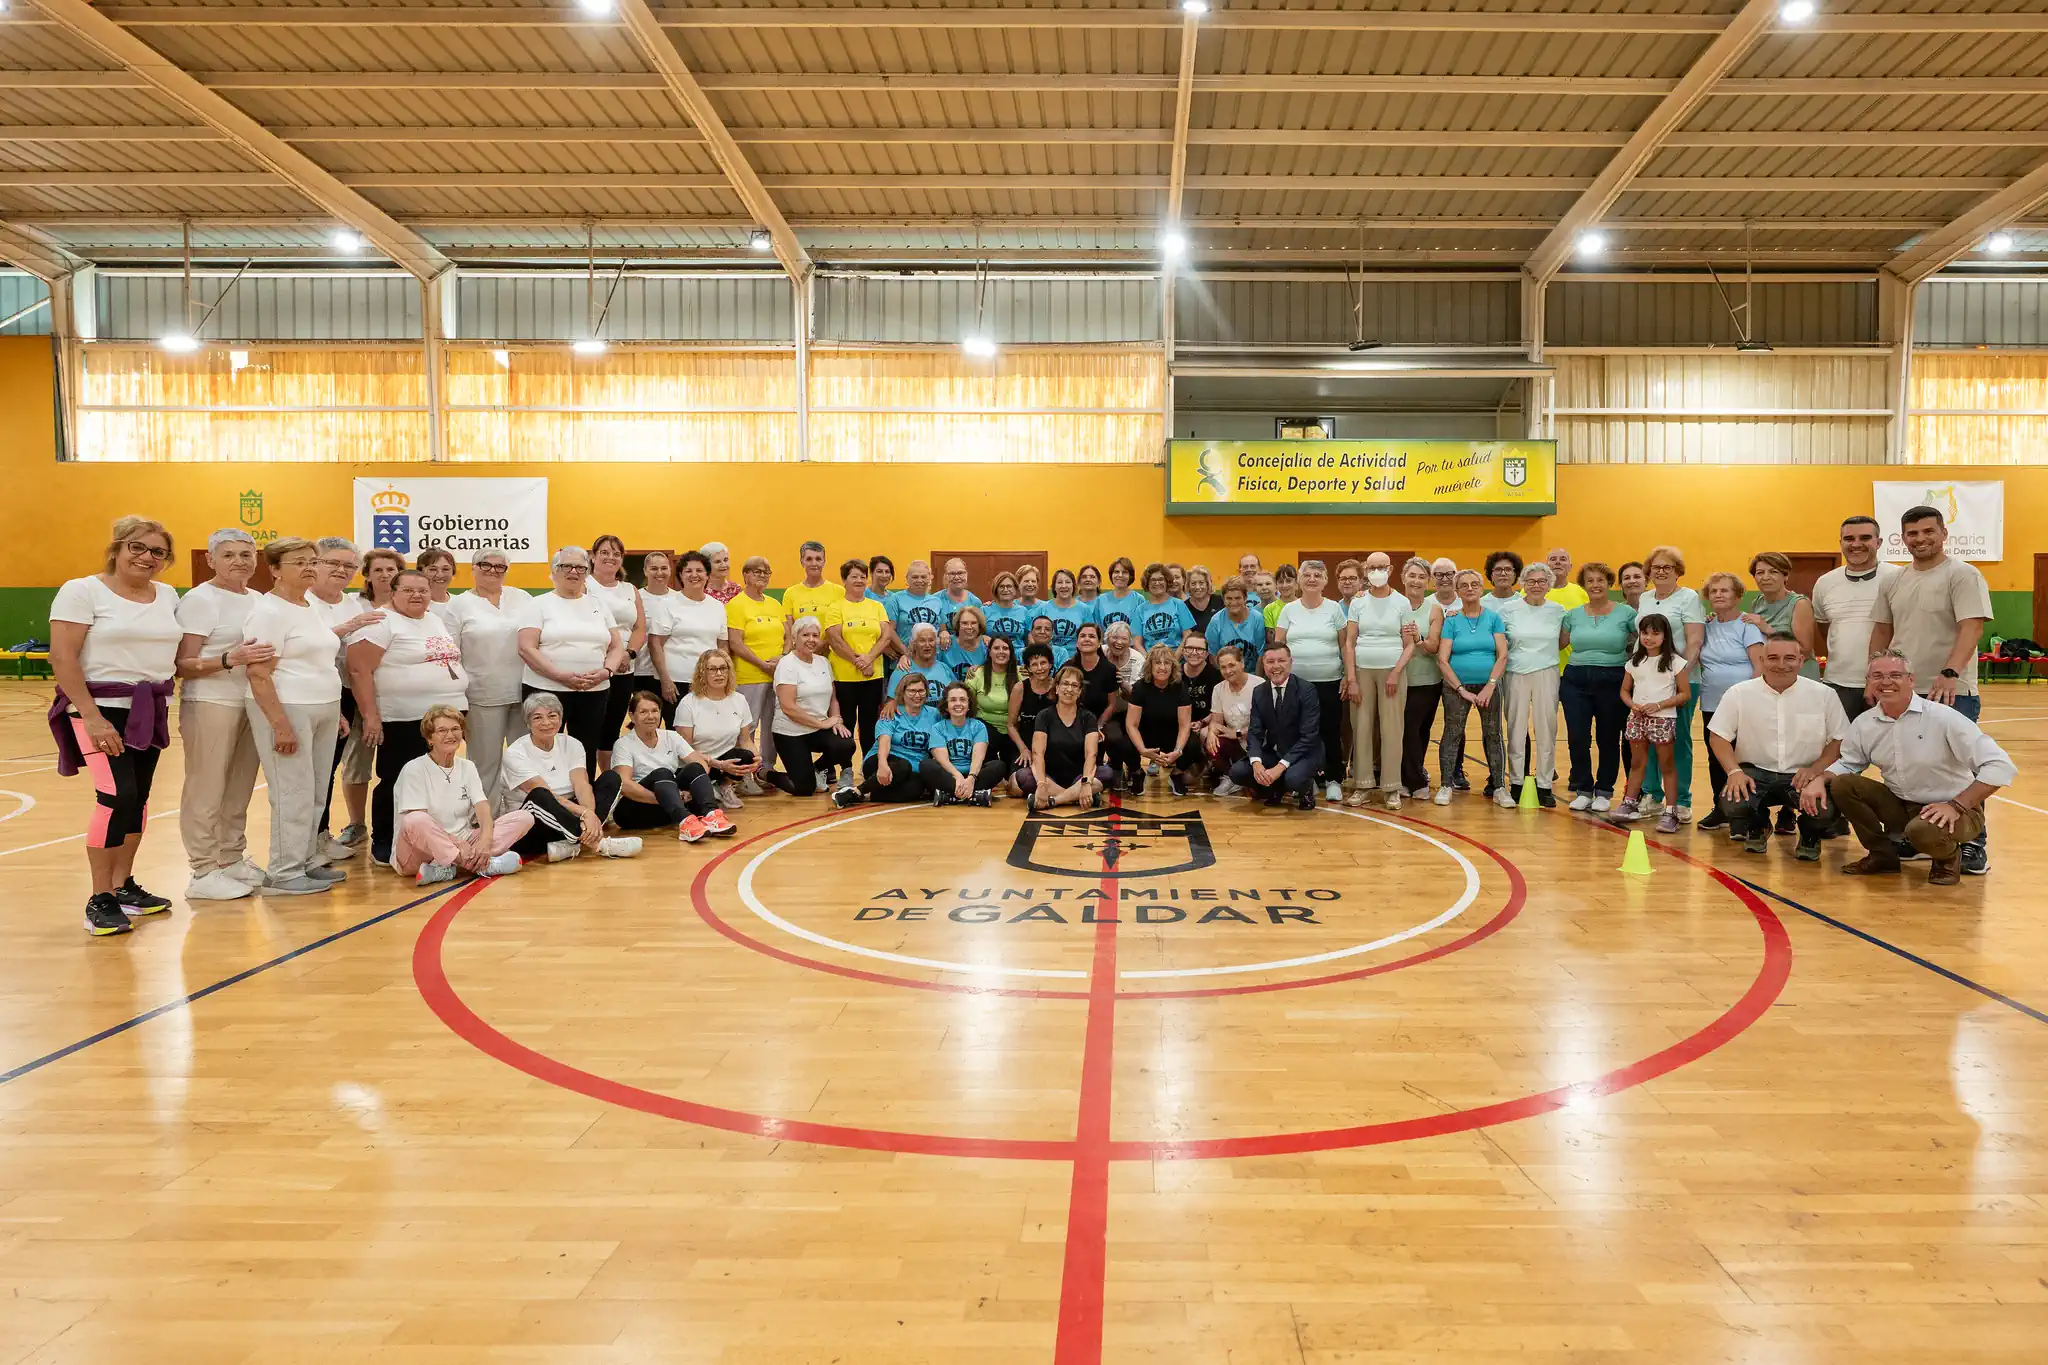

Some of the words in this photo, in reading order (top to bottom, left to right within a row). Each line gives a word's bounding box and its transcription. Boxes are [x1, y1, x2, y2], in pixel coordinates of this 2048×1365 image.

[1238, 452, 1312, 471] Concejalía
[1317, 452, 1335, 467] de
[1339, 452, 1407, 467] Actividad
[1416, 461, 1439, 475] Por
[1441, 458, 1454, 471] tu
[1457, 450, 1492, 468] salud
[1238, 476, 1282, 492] Física,
[1287, 476, 1347, 494] Deporte
[1351, 480, 1360, 494] y
[1363, 475, 1406, 490] Salud
[1433, 476, 1482, 495] muévete
[418, 514, 509, 531] Gobierno
[251, 530, 278, 540] DAR
[418, 534, 441, 550] de
[445, 534, 530, 550] Canarias
[1949, 532, 1986, 545] naria
[1886, 547, 1901, 555] Isla
[1953, 547, 1986, 556] Deporte
[871, 888, 1342, 901] AYUNTAMIENTO
[853, 907, 938, 921] DE
[947, 903, 1324, 925] GÁLDAR
